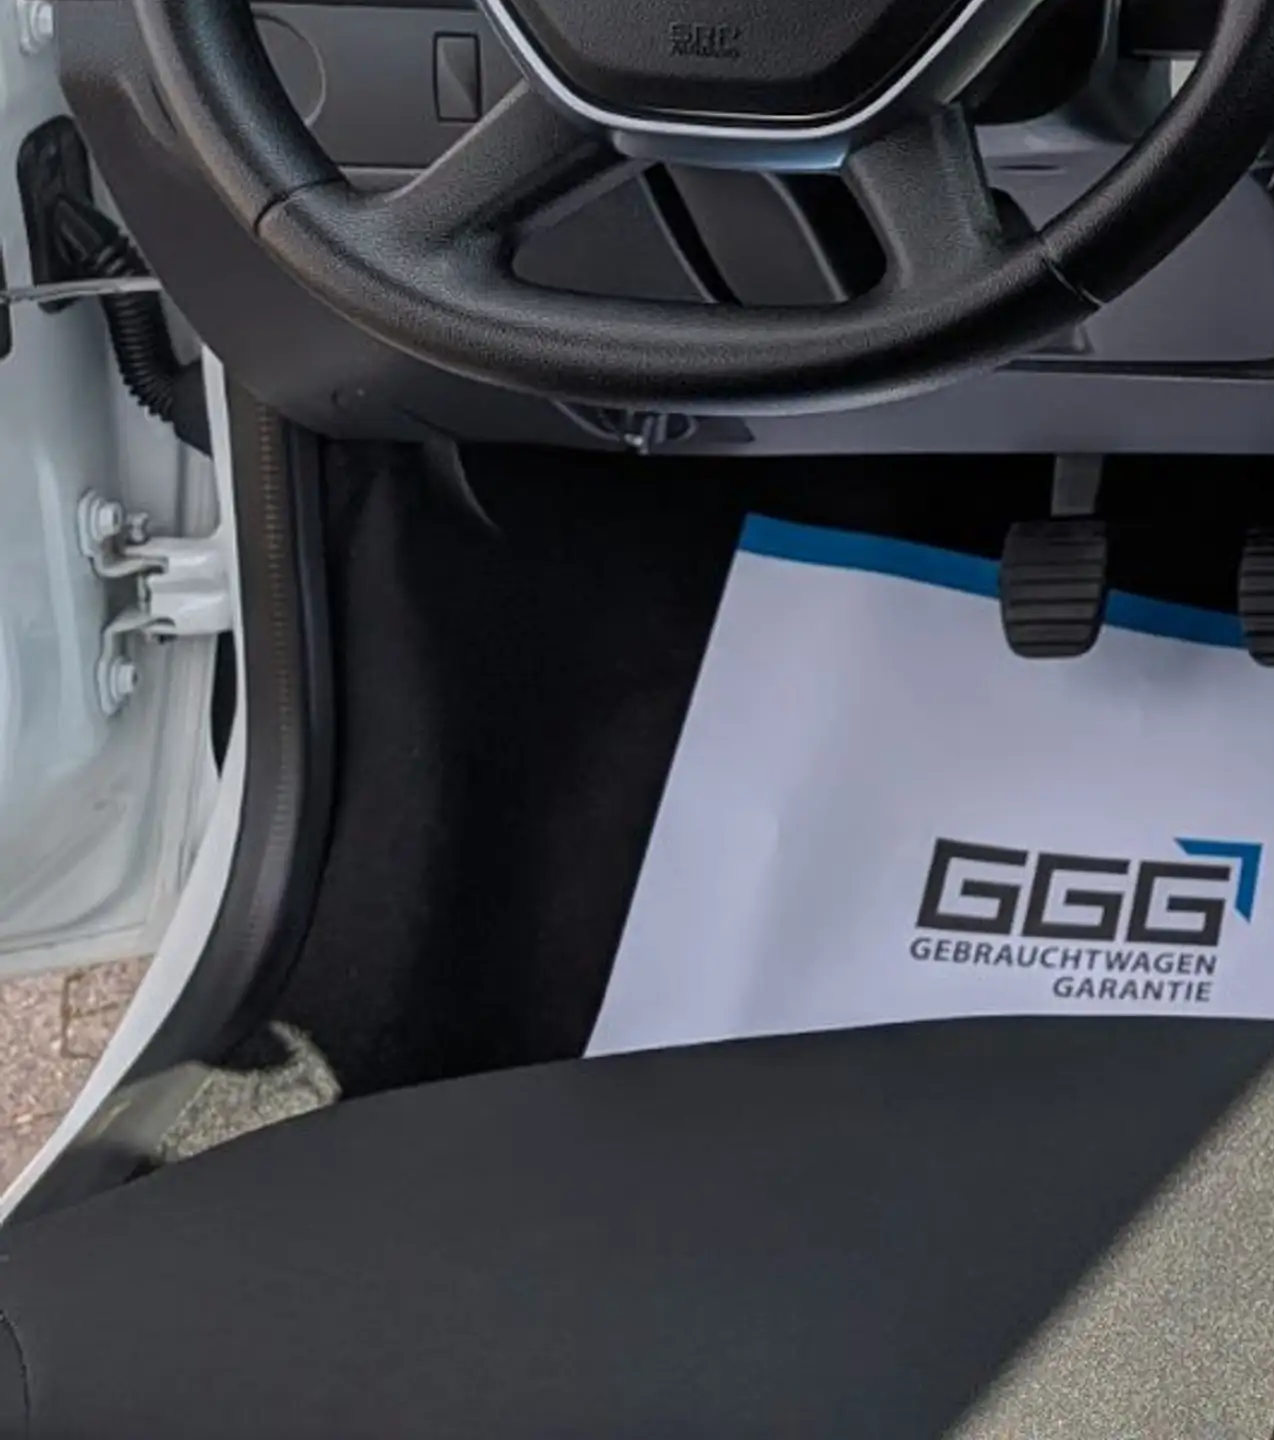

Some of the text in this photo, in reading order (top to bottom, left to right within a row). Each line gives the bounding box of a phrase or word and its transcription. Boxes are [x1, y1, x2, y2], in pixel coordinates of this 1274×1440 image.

[915, 837, 1231, 947] GGG
[909, 936, 1217, 976] GEBRAUCHTWAGEN
[1052, 976, 1212, 1003] GARANTIE
